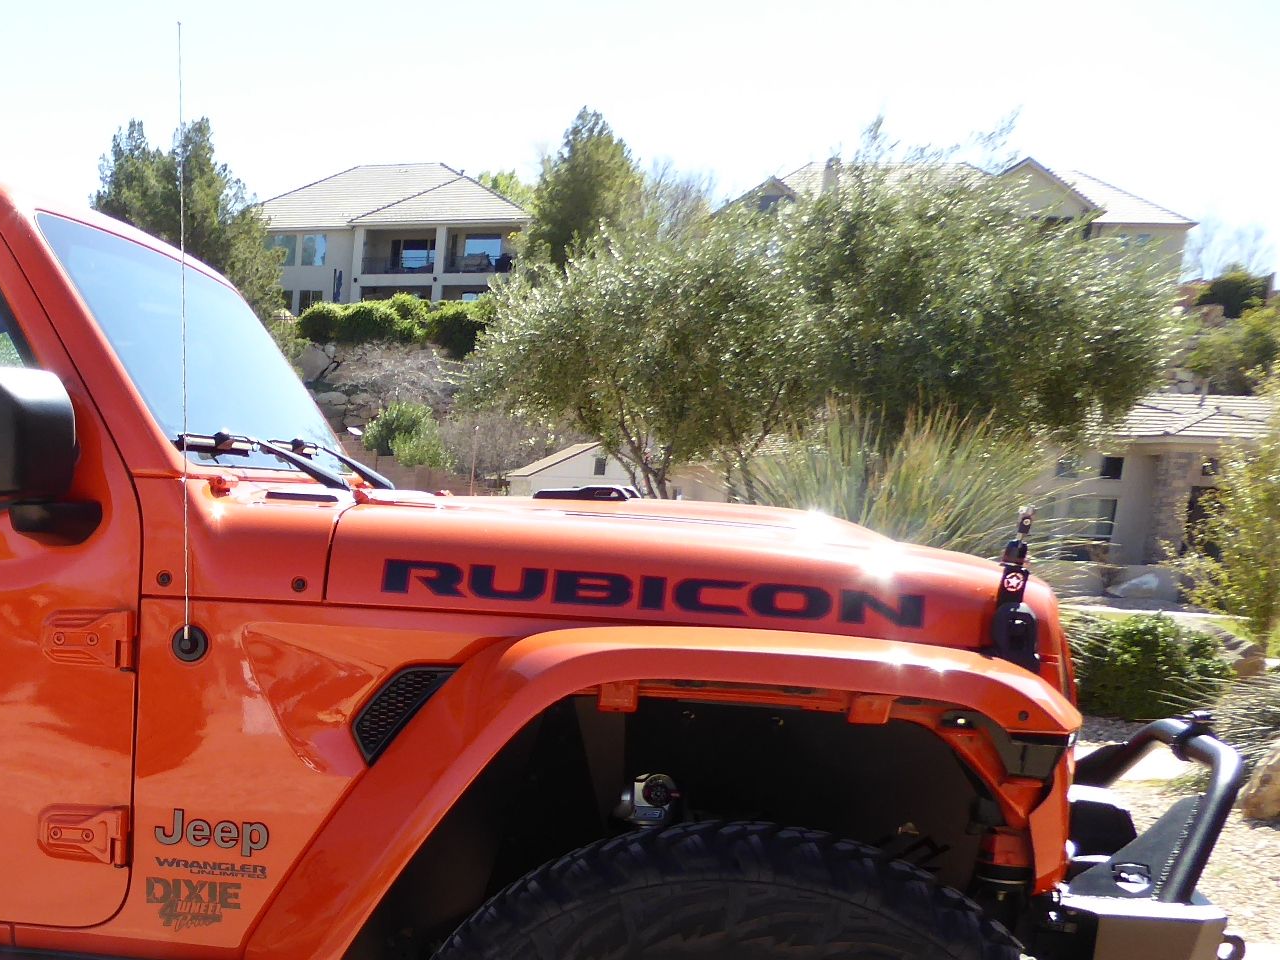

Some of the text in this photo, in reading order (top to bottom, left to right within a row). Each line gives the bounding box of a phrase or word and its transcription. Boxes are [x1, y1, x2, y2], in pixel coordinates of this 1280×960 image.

[381, 557, 925, 629] RUBICON
[154, 808, 269, 857] Jeep
[155, 857, 267, 873] WRANGLER
[189, 869, 268, 879] UNLIMITED
[146, 877, 242, 909] DIXIE
